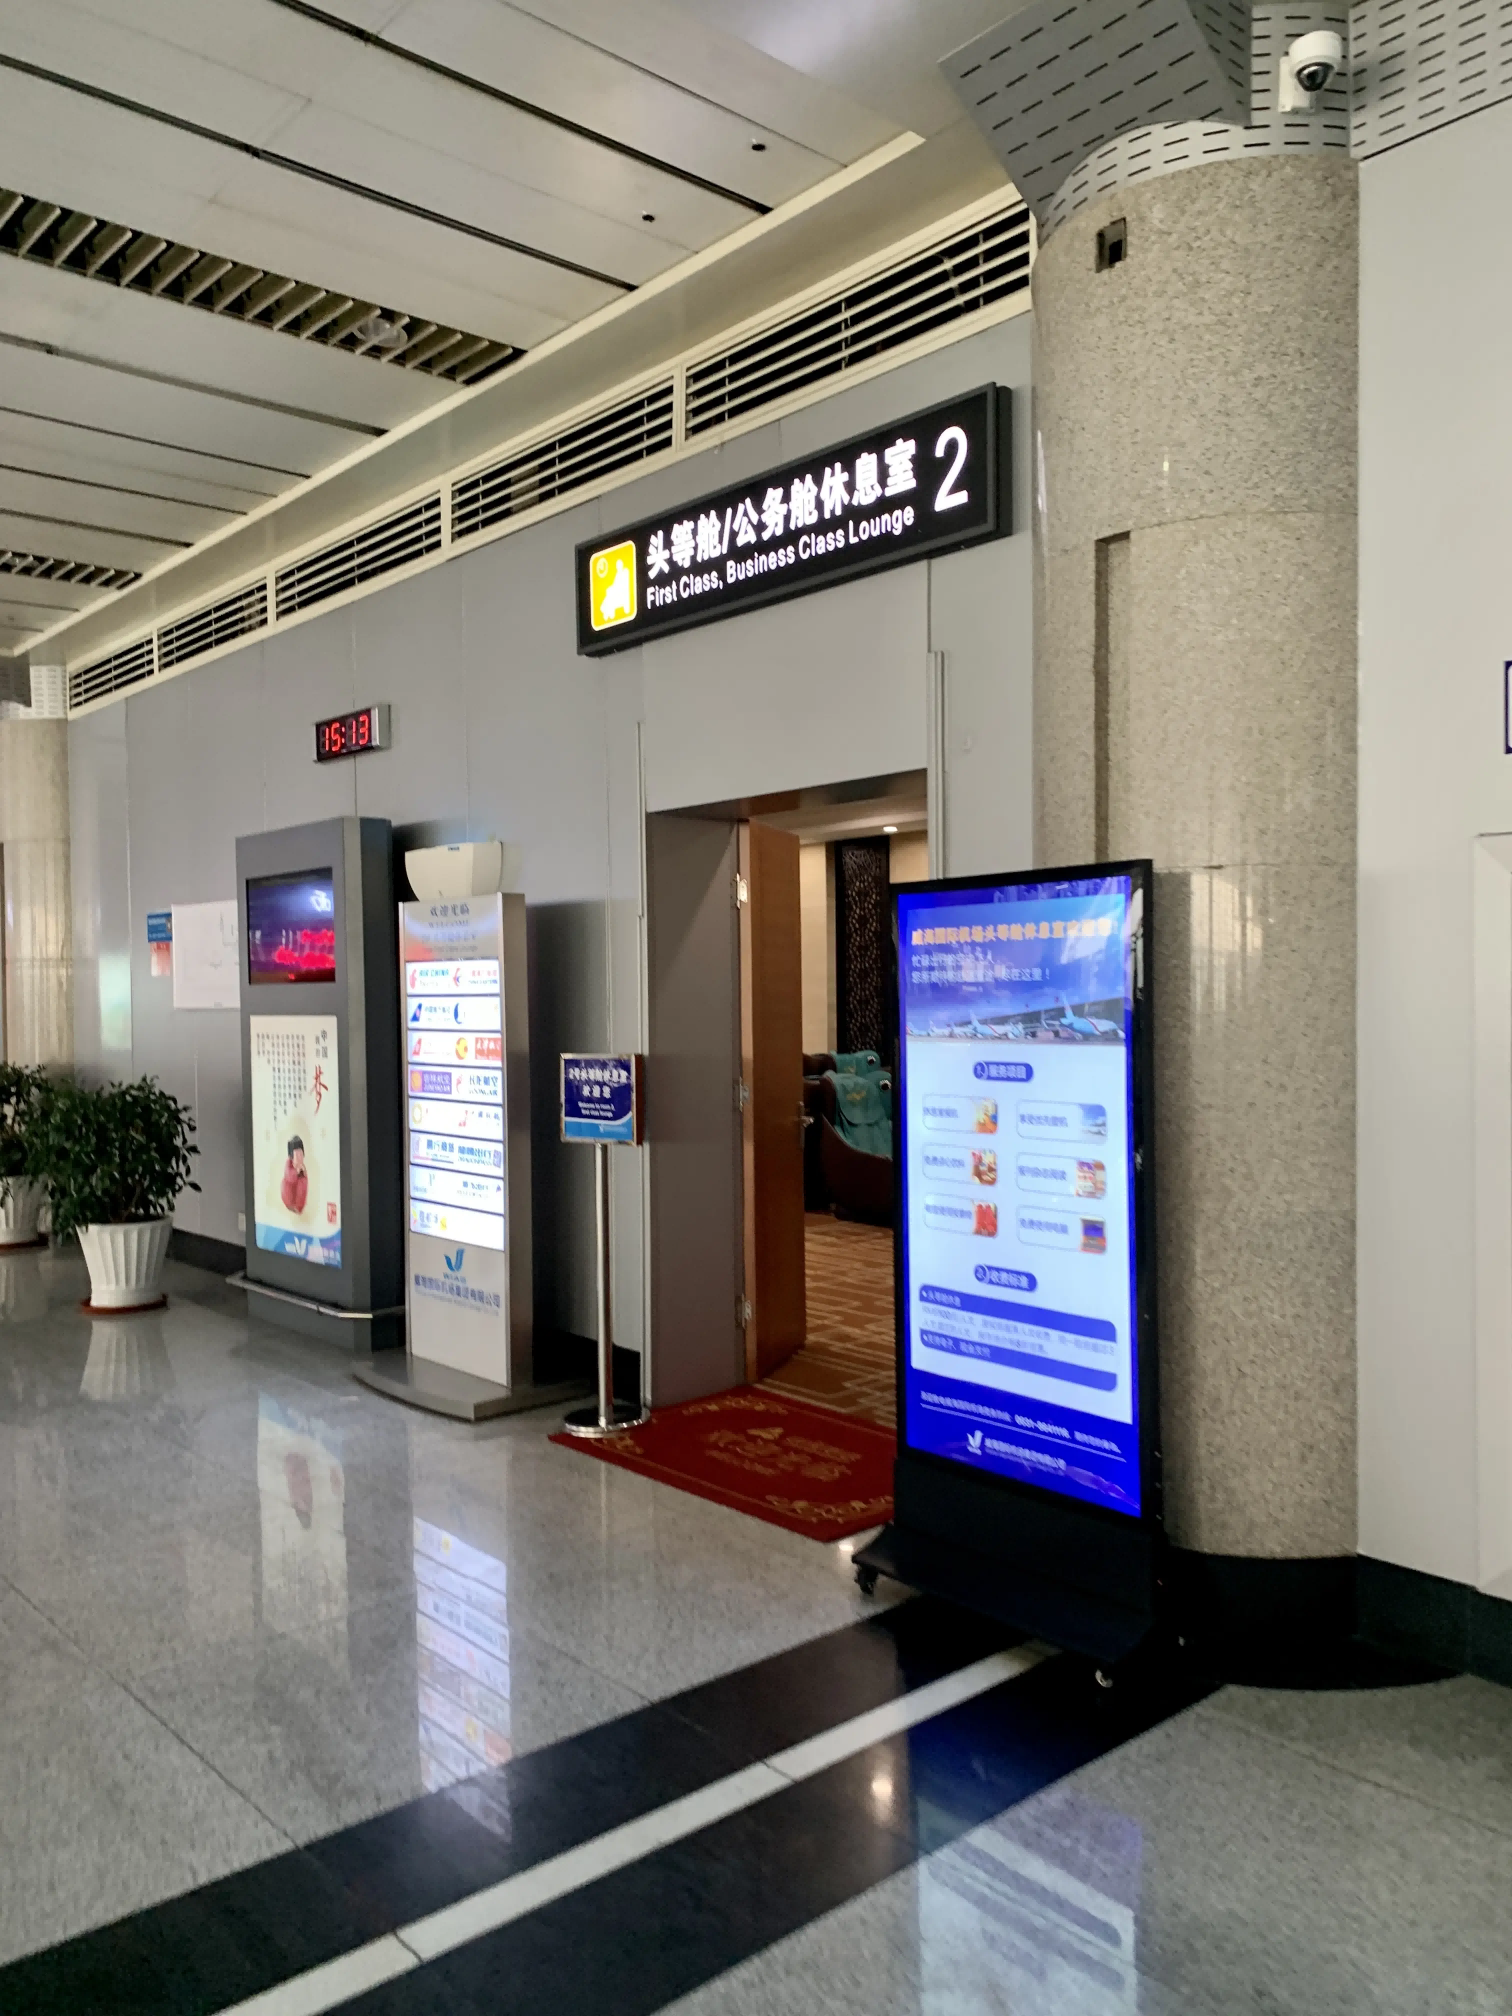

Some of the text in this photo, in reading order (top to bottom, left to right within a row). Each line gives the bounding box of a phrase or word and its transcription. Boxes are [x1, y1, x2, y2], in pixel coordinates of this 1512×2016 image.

[646, 438, 917, 580] 头等舱/公务舱休息室
[934, 425, 969, 513] 2
[646, 505, 915, 610] First Class, Business Class Lounge
[325, 714, 369, 752] 15:13
